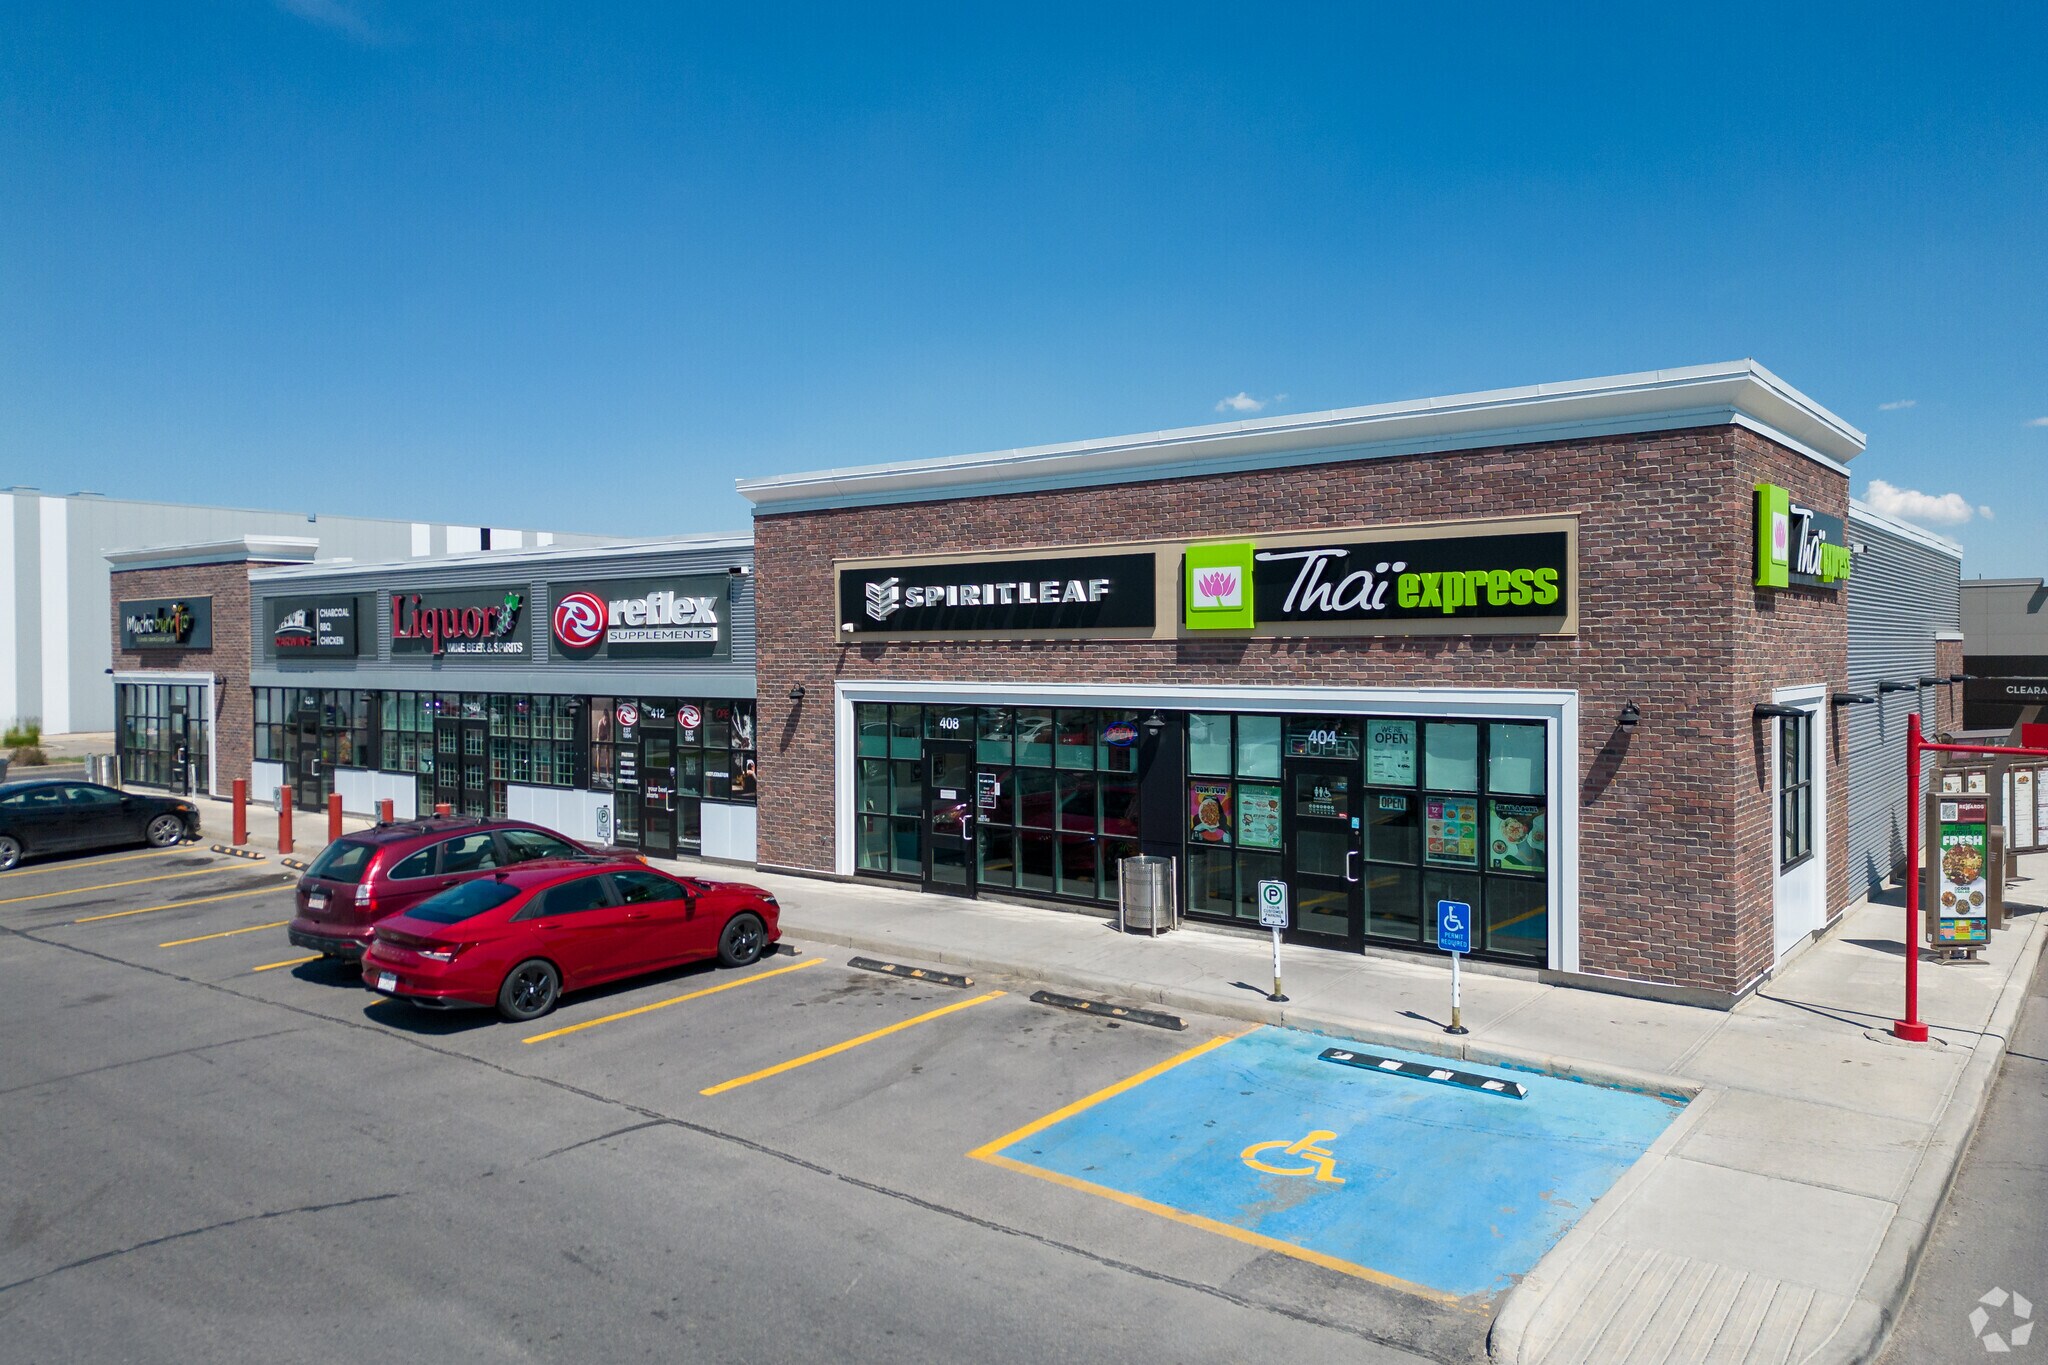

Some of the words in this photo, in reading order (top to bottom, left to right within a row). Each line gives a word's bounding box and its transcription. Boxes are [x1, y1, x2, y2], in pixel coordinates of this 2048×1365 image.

[1255, 549, 1407, 612] Thaï
[1398, 568, 1558, 614] express
[905, 578, 1109, 608] SPIRITLEAF
[320, 608, 349, 617] CHARCOAL
[608, 590, 718, 626] reflex
[320, 622, 332, 632] BBQ
[391, 594, 499, 655] Liquor
[275, 635, 311, 647] DARWIN'S
[320, 635, 344, 645] CHICKEN
[610, 629, 712, 641] SUPPLEMENTS
[447, 642, 465, 653] WINE
[466, 642, 486, 653] BEER
[494, 641, 523, 653] SPIRITS
[651, 708, 665, 719] 412
[716, 709, 729, 719] OPE
[939, 717, 959, 730] 408
[1381, 725, 1403, 733] WE'RE
[1106, 726, 1134, 739] OPEN
[1308, 729, 1337, 745] 404
[1375, 732, 1408, 745] OPEN
[1195, 786, 1209, 794] TOM
[1211, 786, 1227, 795] YUM
[1381, 796, 1405, 810] OPEN
[1942, 835, 1983, 846] FRESH
[1269, 889, 1278, 900] P
[1444, 931, 1463, 940] PERMIT
[1441, 938, 1467, 948] REQUIRED
